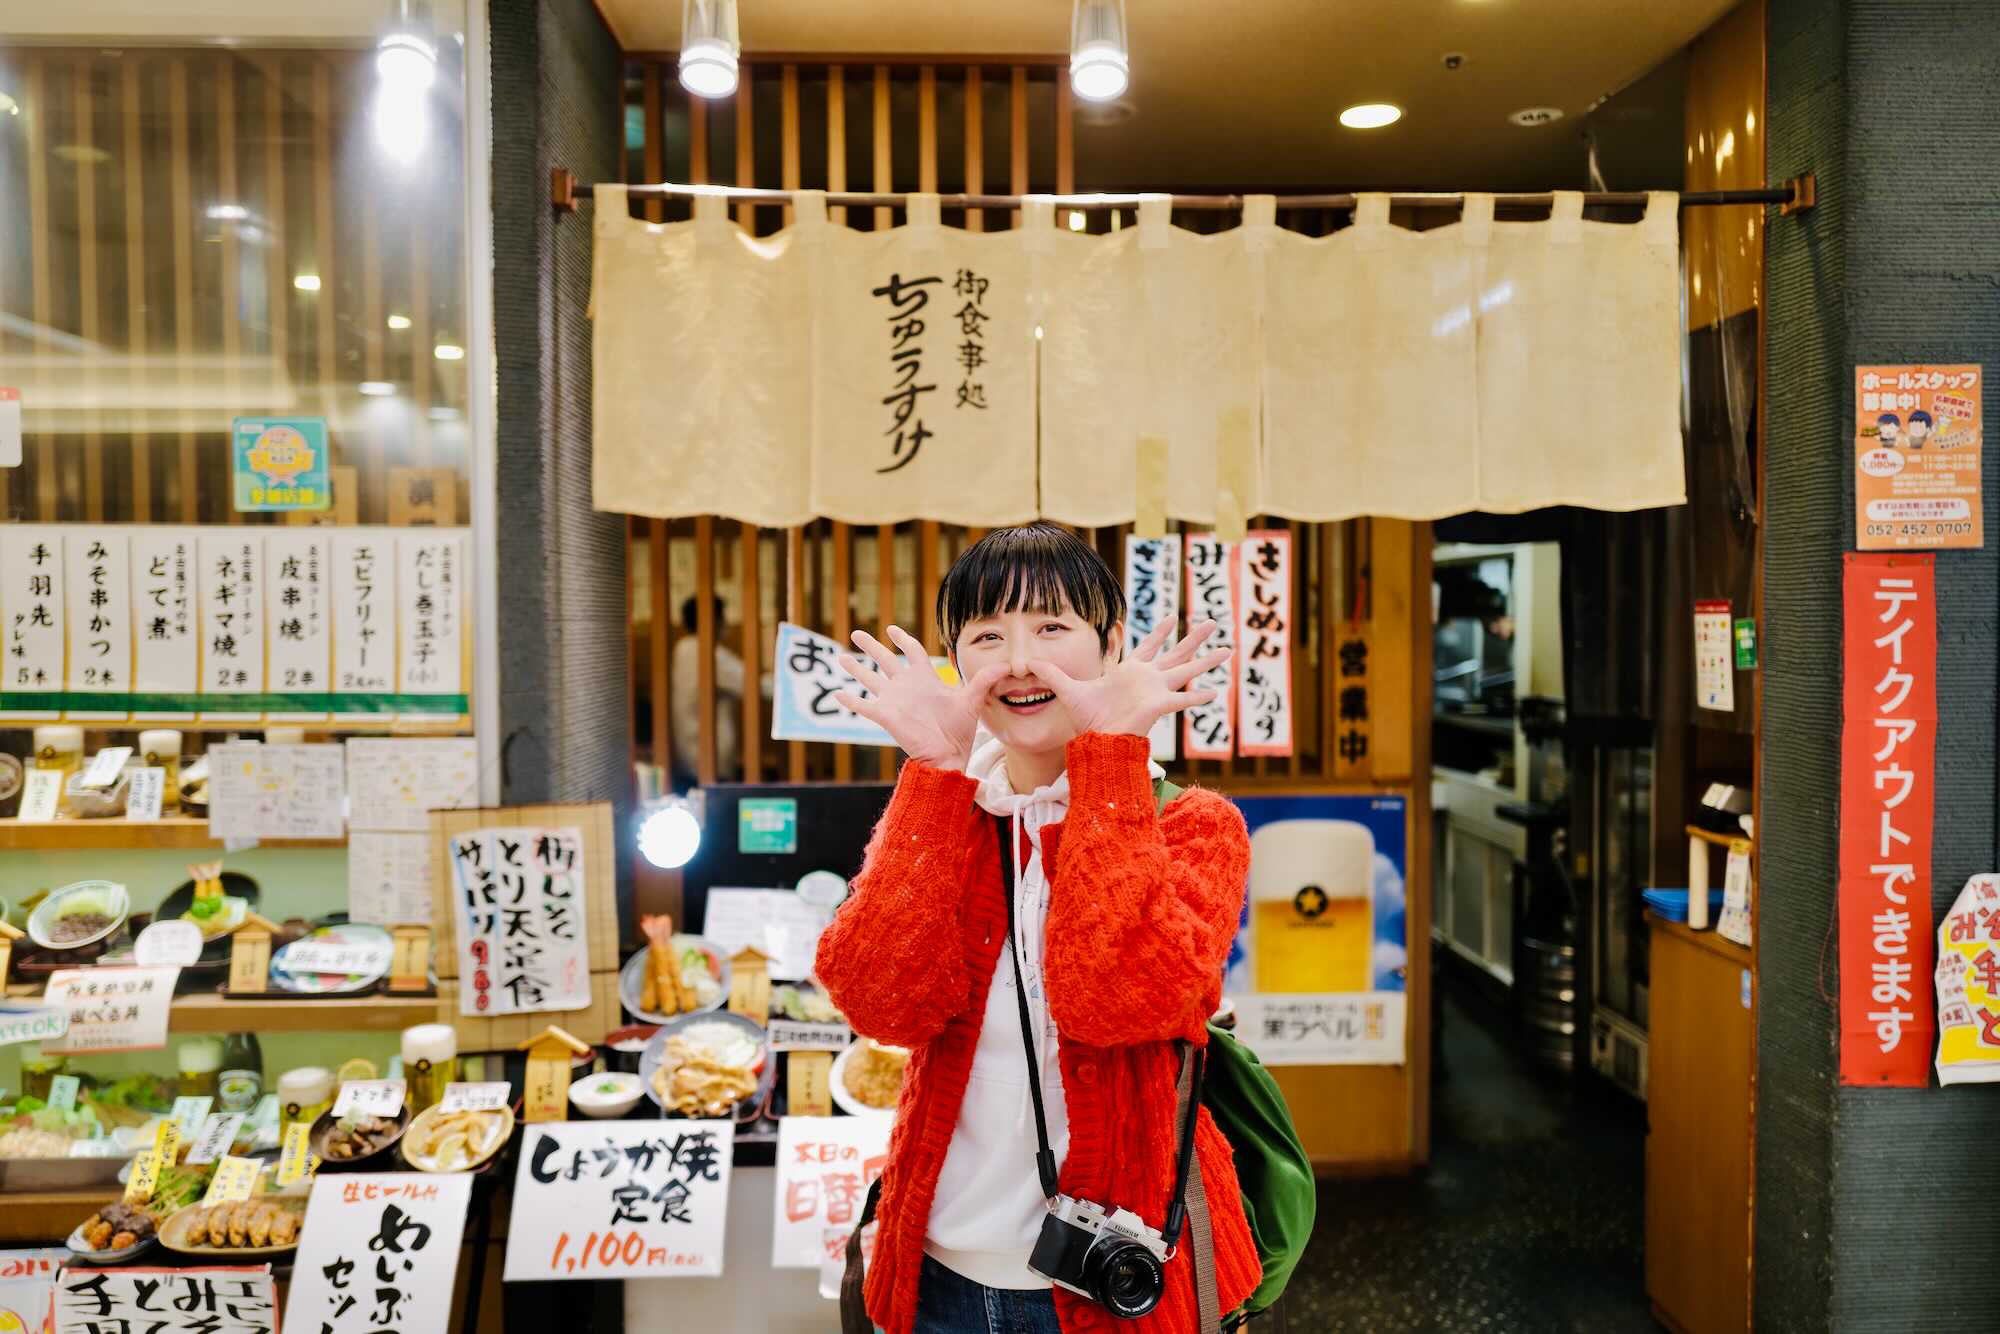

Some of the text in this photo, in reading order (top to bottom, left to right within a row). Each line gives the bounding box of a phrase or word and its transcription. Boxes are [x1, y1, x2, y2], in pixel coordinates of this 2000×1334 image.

[953, 268, 990, 409] 御食事処
[1862, 373, 1977, 390] ホールスタッフ
[29, 543, 53, 626] 手羽先
[87, 541, 111, 657] みそ串かつ
[148, 556, 171, 640] どて煮
[213, 556, 238, 657] ネギマ焼
[280, 556, 305, 641] 皮串焼
[353, 547, 376, 668] エビフリャー
[414, 546, 436, 664] だし巻玉子
[1246, 541, 1284, 660] きしめん
[1339, 640, 1368, 763] 営業中
[1868, 578, 1918, 1053] テイクアウトできます
[1263, 1019, 1356, 1041] 黒ラベル
[531, 1129, 720, 1183] しょうが焼
[611, 1178, 693, 1225] 定食
[794, 1142, 858, 1164] 本日の
[369, 1204, 431, 1334] めいぶ
